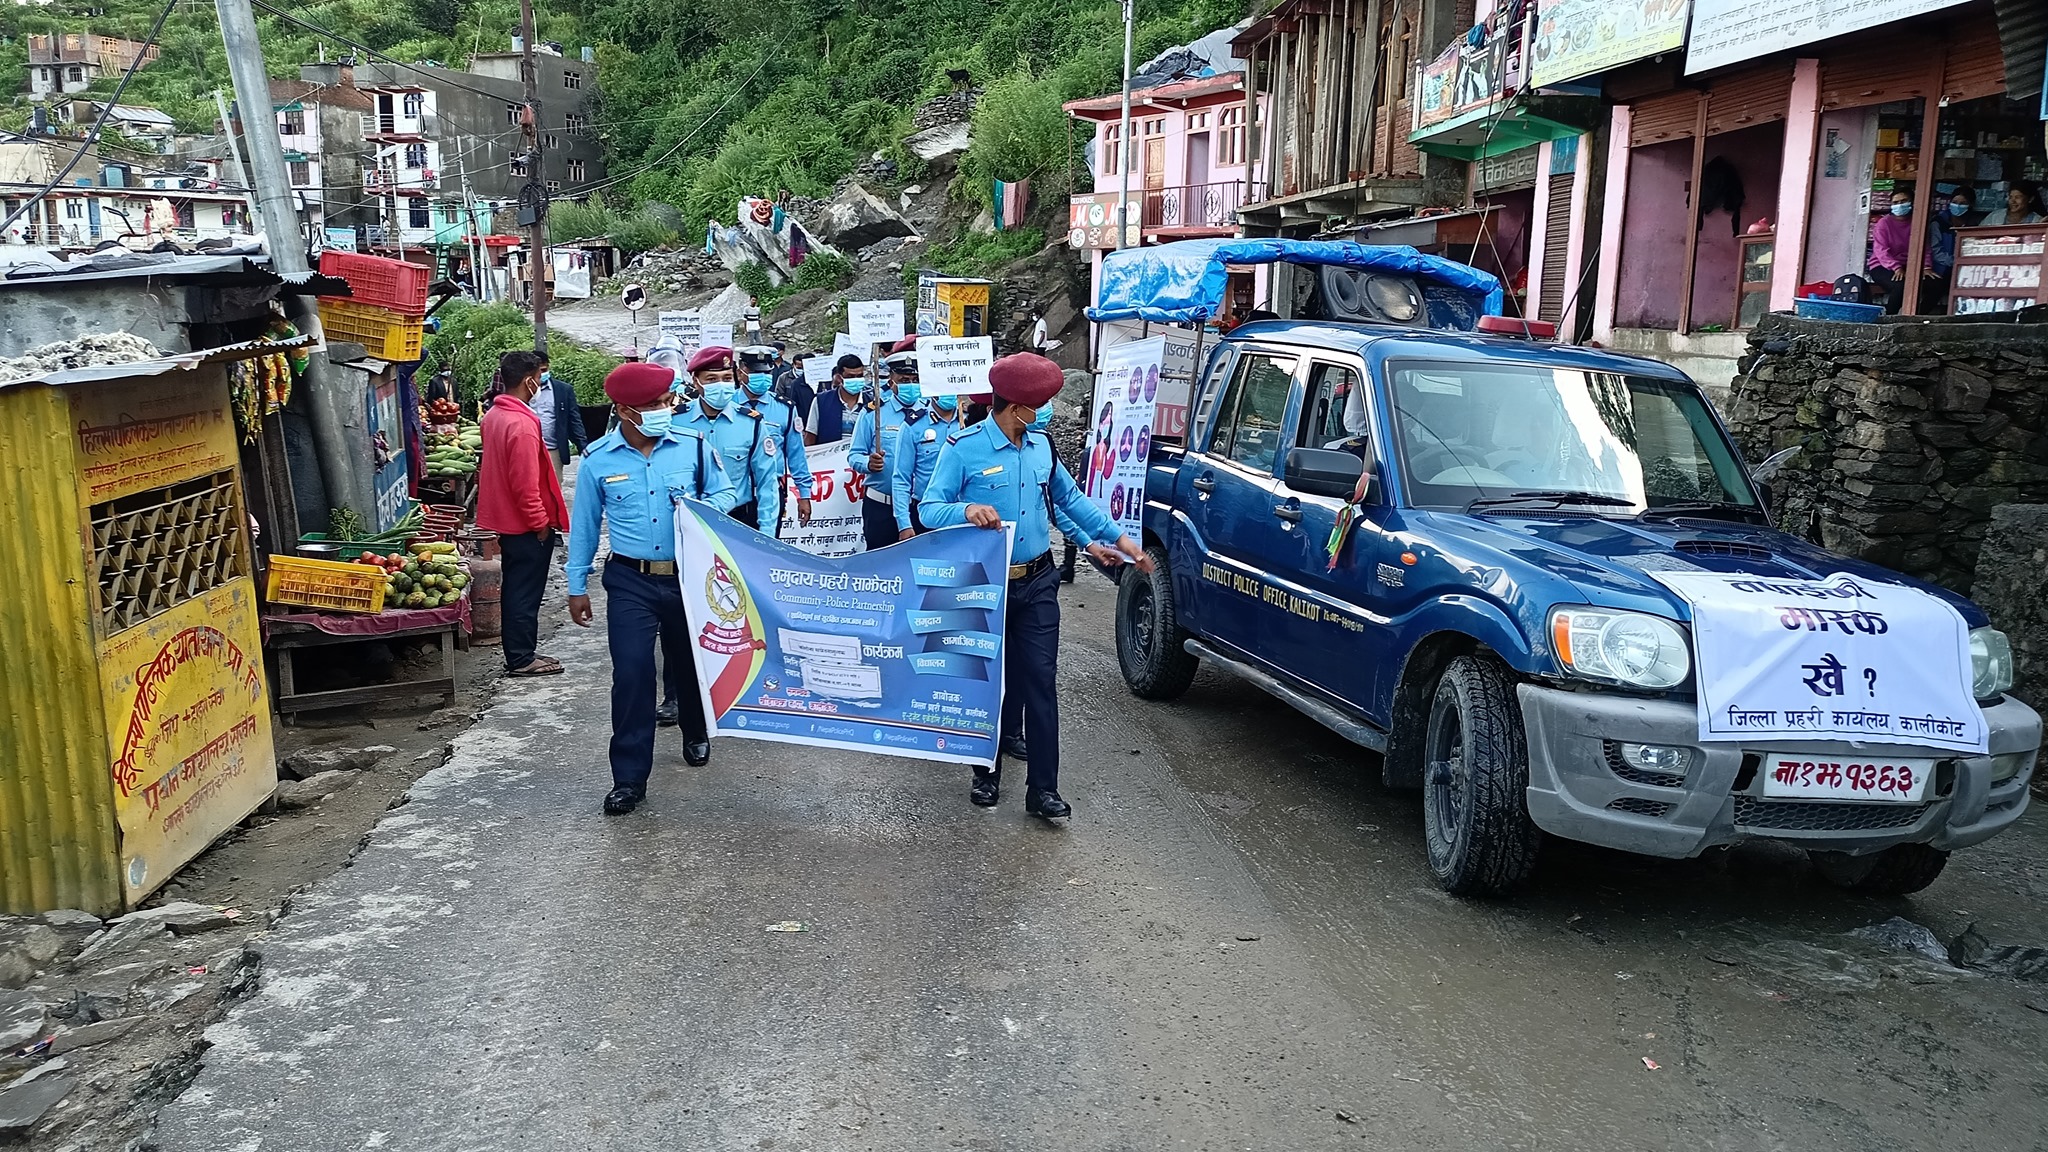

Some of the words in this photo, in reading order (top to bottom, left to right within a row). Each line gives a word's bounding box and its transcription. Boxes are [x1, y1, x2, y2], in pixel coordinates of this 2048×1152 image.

[1507, 153, 1537, 179] होटल
[972, 358, 986, 368] हात
[769, 568, 849, 591] समुदाय-प्रहरी
[852, 574, 904, 595] साझेदारी
[918, 564, 937, 576] नेपाल
[939, 566, 956, 578] प्रहरी
[774, 590, 850, 609] Community-Police
[851, 597, 895, 615] Partnership
[956, 591, 984, 601] स्थानीय
[986, 592, 998, 602] तह
[1203, 562, 1231, 587] DISTRICT
[1234, 574, 1258, 598] POLICE
[1290, 596, 1320, 622] KALIKOT
[914, 616, 942, 627] समुदाय
[1775, 606, 1888, 635] मास्क
[862, 642, 904, 660] कार्यक्रम
[942, 635, 976, 646] सामाजिक
[977, 638, 995, 650] संस्था
[1802, 652, 1847, 697] खै
[1863, 668, 1877, 698] ?
[1727, 704, 1776, 728] जिल्ला
[1784, 706, 1824, 730] प्रहरी
[1898, 714, 1966, 738] कालीकोट
